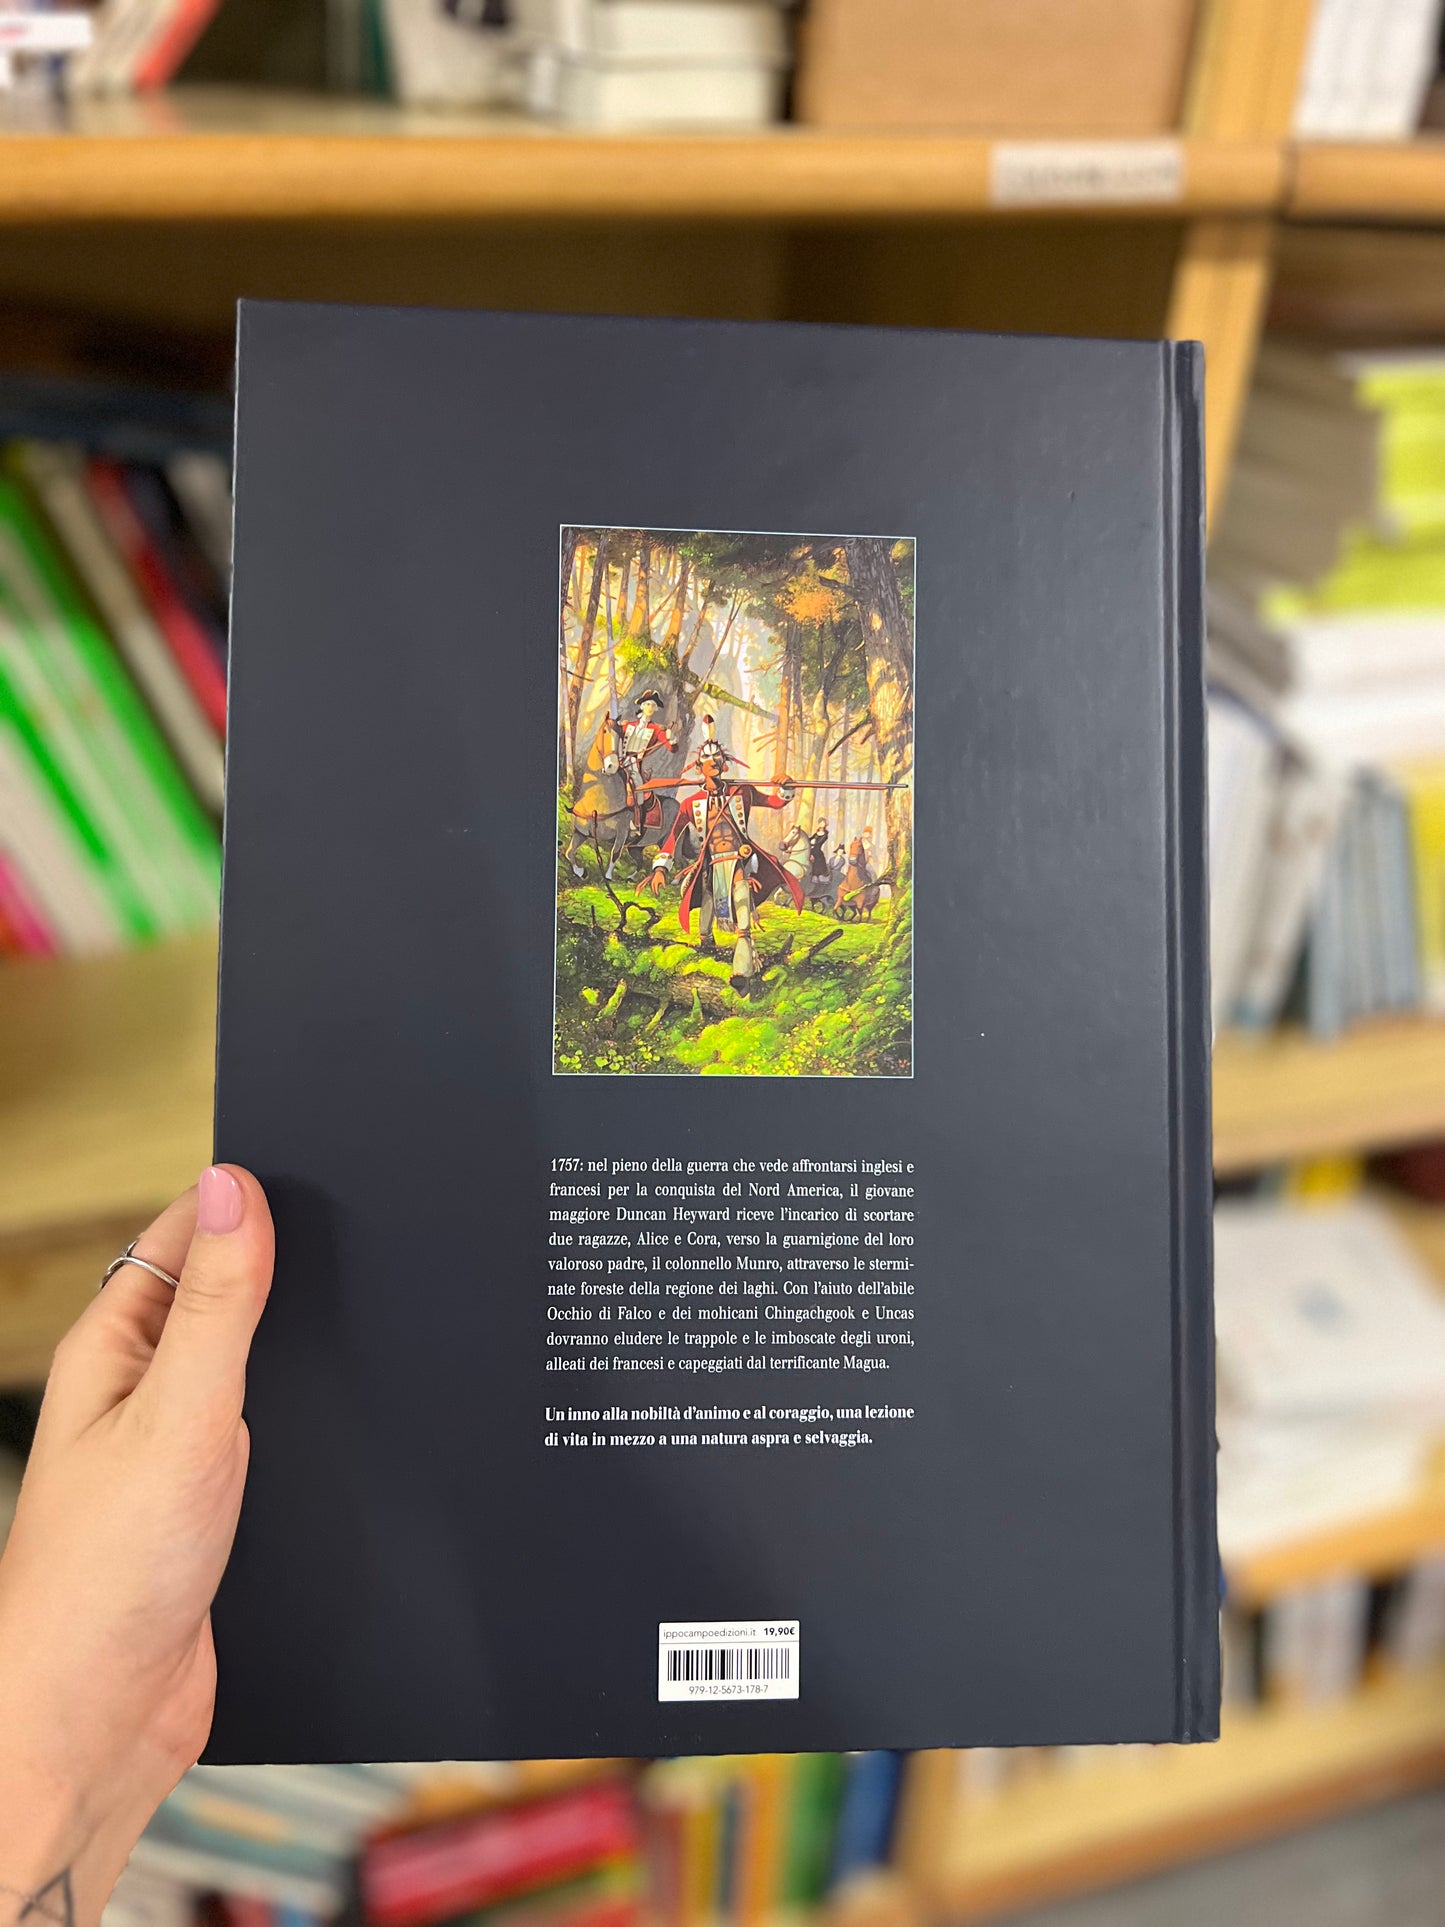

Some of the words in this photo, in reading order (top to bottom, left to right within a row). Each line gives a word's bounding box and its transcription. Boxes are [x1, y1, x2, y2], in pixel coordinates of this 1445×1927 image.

[551, 1158, 583, 1171] 1757:
[588, 1158, 607, 1171] nel
[612, 1158, 647, 1175] pieno
[652, 1158, 682, 1171] della
[687, 1162, 728, 1175] guerra
[733, 1158, 755, 1172] che
[759, 1159, 788, 1172] vede
[792, 1159, 857, 1172] affrontarsi
[862, 1160, 902, 1176] inglesi
[907, 1163, 914, 1173] e
[550, 1183, 600, 1196] francesi
[608, 1186, 629, 1199] per
[636, 1183, 648, 1196] la
[655, 1183, 715, 1199] conquista
[723, 1183, 741, 1196] del
[749, 1183, 780, 1196] Nord
[787, 1183, 843, 1199] America,
[850, 1183, 858, 1197] il
[865, 1184, 914, 1200] giovane
[549, 1207, 610, 1224] maggiore
[616, 1207, 666, 1220] Duncan
[673, 1207, 730, 1224] Heyward
[737, 1207, 774, 1220] riceve
[845, 1208, 857, 1221] di
[864, 1210, 914, 1221] scortare
[549, 1232, 573, 1245] due
[578, 1235, 631, 1248] ragazze,
[637, 1232, 669, 1245] Alice
[674, 1235, 681, 1245] e
[687, 1232, 720, 1248] Cora,
[726, 1235, 760, 1245] verso
[766, 1232, 777, 1245] la
[783, 1232, 859, 1249] guarnigione
[864, 1232, 883, 1245] del
[889, 1233, 914, 1245] loro
[548, 1257, 603, 1270] valoroso
[608, 1256, 647, 1274] padre,
[652, 1256, 661, 1270] il
[665, 1256, 731, 1270] colonnello
[736, 1256, 782, 1272] Munro,
[787, 1258, 849, 1270] attraverso
[854, 1257, 865, 1270] le
[869, 1257, 914, 1270] stermi-
[548, 1283, 575, 1295] nate
[581, 1282, 624, 1295] foreste
[629, 1281, 660, 1295] della
[666, 1282, 713, 1298] regione
[719, 1281, 738, 1294] dei
[743, 1281, 778, 1298] laghi.
[783, 1281, 808, 1294] Con
[547, 1307, 592, 1320] Occhio
[599, 1306, 611, 1320] di
[618, 1306, 651, 1320] Falco
[659, 1310, 666, 1320] e
[672, 1306, 691, 1319] dei
[698, 1306, 758, 1319] mohicani
[765, 1306, 855, 1323] Chingachgook
[862, 1310, 869, 1319] e
[875, 1306, 914, 1319] Uncas
[547, 1332, 608, 1345] dovranno
[614, 1331, 662, 1345] eludere
[668, 1331, 679, 1344] le
[685, 1331, 737, 1348] trappole
[743, 1334, 749, 1344] e
[755, 1331, 766, 1344] le
[772, 1331, 836, 1344] imboscate
[841, 1331, 871, 1347] degli
[877, 1331, 914, 1347] uroni,
[546, 1357, 585, 1370] alleati
[590, 1357, 609, 1370] dei
[613, 1356, 664, 1370] francesi
[668, 1360, 675, 1369] e
[679, 1356, 743, 1373] capeggiati
[747, 1356, 766, 1369] dal
[770, 1355, 840, 1369] terrificante
[843, 1355, 889, 1372] Magua.
[546, 1407, 565, 1421] Un
[568, 1407, 600, 1420] inno
[602, 1407, 628, 1420] alla
[631, 1406, 681, 1420] nobiltà
[743, 1410, 751, 1419] e
[754, 1406, 766, 1419] al
[769, 1405, 833, 1422] coraggio,
[837, 1409, 862, 1418] una
[865, 1405, 914, 1418] lezione
[545, 1433, 558, 1446] di
[563, 1432, 588, 1446] vita
[592, 1432, 606, 1446] in
[610, 1435, 655, 1445] mezzo
[659, 1435, 667, 1445] a
[671, 1435, 697, 1445] una
[702, 1433, 748, 1445] natura
[752, 1434, 789, 1448] aspra
[793, 1434, 801, 1444] e
[805, 1430, 872, 1447] selvaggia.
[663, 1628, 756, 1639] ippocampoedizioni.it
[763, 1627, 795, 1637] 19,90€
[689, 1684, 769, 1695] 979-12-5673-178-7
